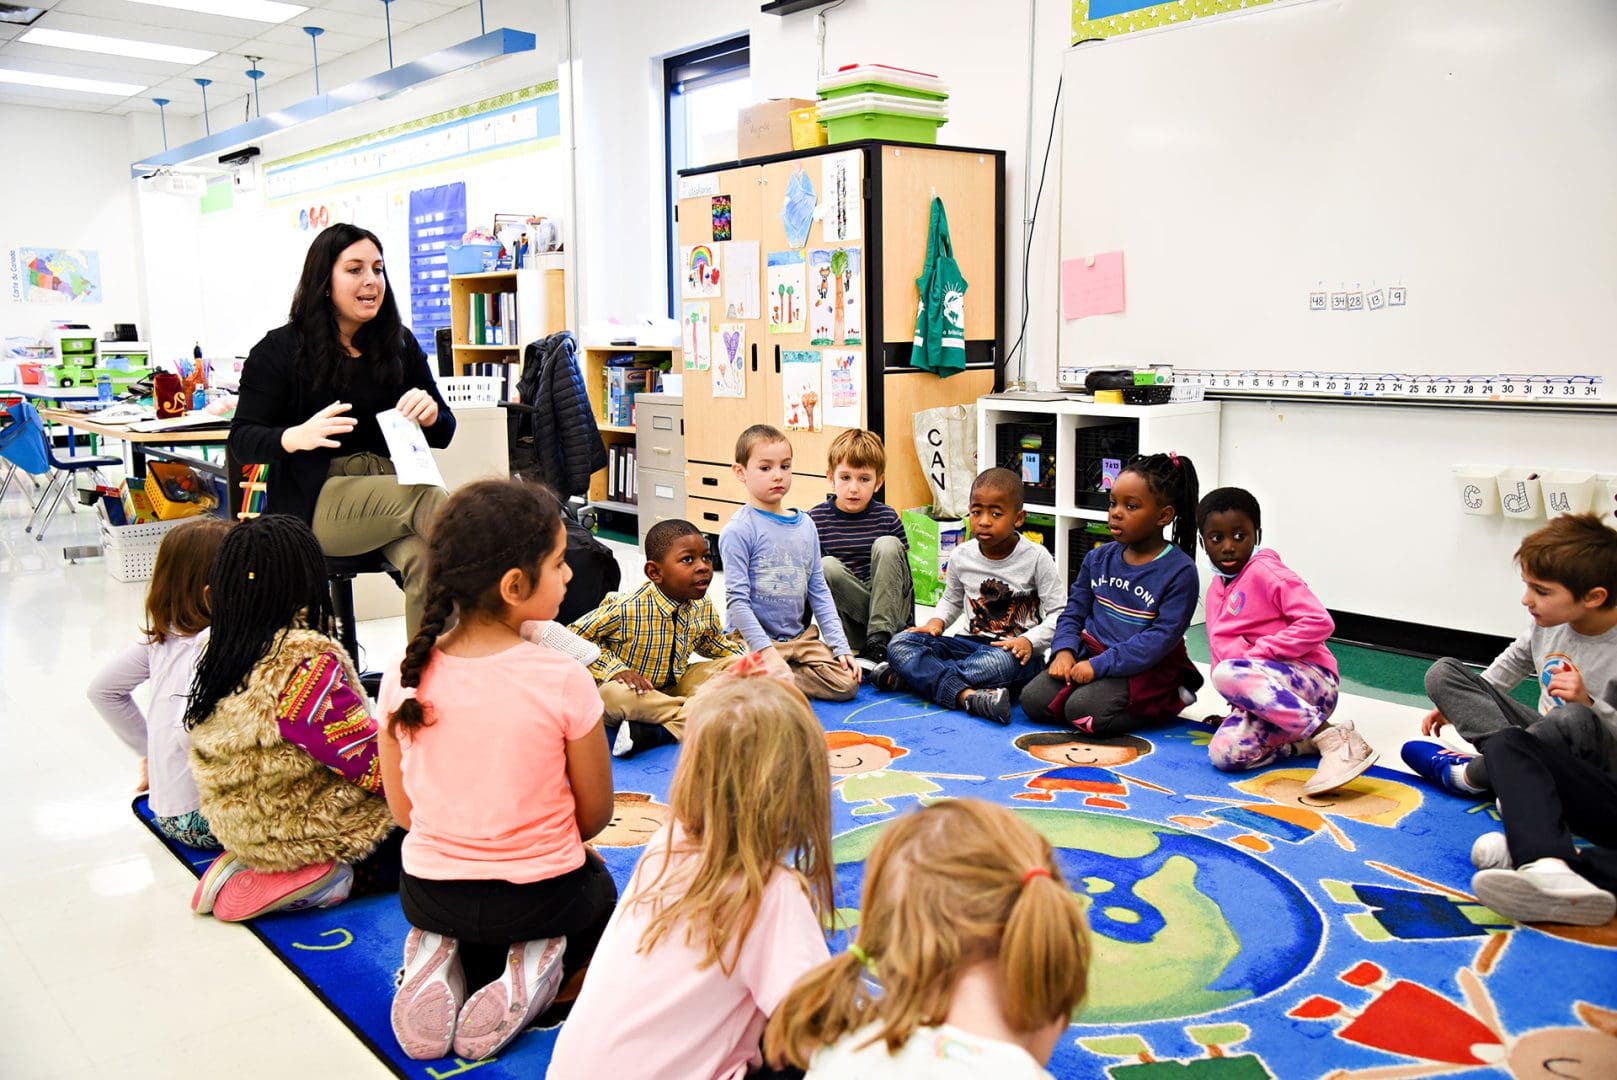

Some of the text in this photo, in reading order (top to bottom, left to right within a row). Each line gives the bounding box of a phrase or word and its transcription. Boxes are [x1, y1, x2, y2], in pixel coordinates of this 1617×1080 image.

[1311, 296, 1324, 306] 48
[1334, 296, 1345, 306] 34
[1349, 296, 1362, 307] 28
[1393, 291, 1401, 303] 9
[1223, 379, 1230, 387] 13
[1237, 379, 1244, 387] 14
[1252, 379, 1259, 387] 15
[1266, 379, 1274, 387] 16
[1281, 379, 1289, 387] 17
[1297, 379, 1304, 388] 18
[1312, 380, 1320, 388] 19
[1326, 381, 1337, 390] 20
[1344, 382, 1351, 390] 21
[1358, 382, 1368, 391] 22
[1375, 382, 1385, 391] 23
[1392, 383, 1402, 392] 24
[1409, 384, 1419, 393] 25
[1426, 384, 1437, 394] 26
[1444, 384, 1455, 394] 27
[1463, 385, 1474, 394] 28
[1481, 385, 1493, 394] 29
[1501, 384, 1514, 393] 30
[1523, 384, 1532, 394] 31
[1542, 385, 1554, 395] 32
[1563, 386, 1575, 395] 33
[1584, 386, 1597, 395] 34
[927, 428, 946, 491] CAN
[1463, 481, 1571, 513] c d u
[1109, 577, 1130, 592] FOR
[1133, 585, 1155, 608] ONE
